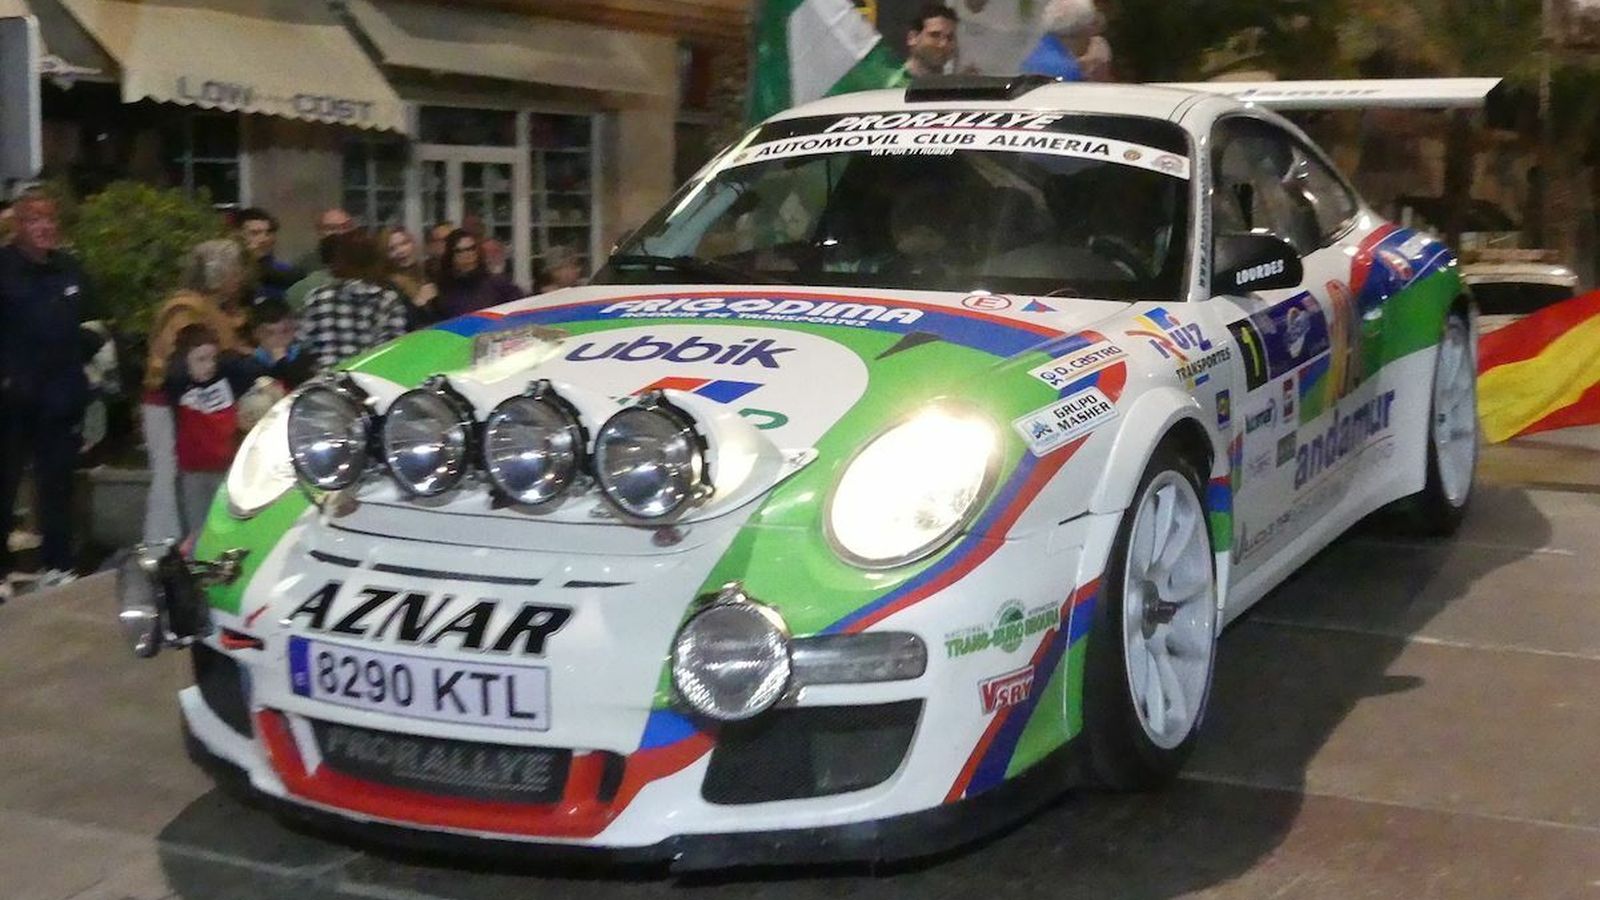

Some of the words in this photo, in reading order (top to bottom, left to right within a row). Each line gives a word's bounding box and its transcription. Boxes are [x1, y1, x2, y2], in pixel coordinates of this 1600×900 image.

[177, 76, 252, 106] LOW
[295, 94, 374, 119] COST
[823, 111, 1063, 133] PRORALLYE
[755, 133, 898, 158] AUTOMOVIL
[913, 132, 976, 146] CLUB
[988, 134, 1111, 156] ALMERIA
[1236, 259, 1284, 285] LOURDES
[600, 298, 924, 325] FRIGODIMA
[737, 312, 870, 327] TRANSPORTES
[565, 335, 798, 369] ubbik
[1175, 346, 1232, 384] TRANSPORTES
[1053, 393, 1098, 419] GRUPO
[1057, 401, 1112, 432] MASHER
[1294, 388, 1395, 491] andamur
[287, 579, 574, 657] AZNAR
[316, 651, 414, 707] 8290
[433, 667, 537, 720] KTL
